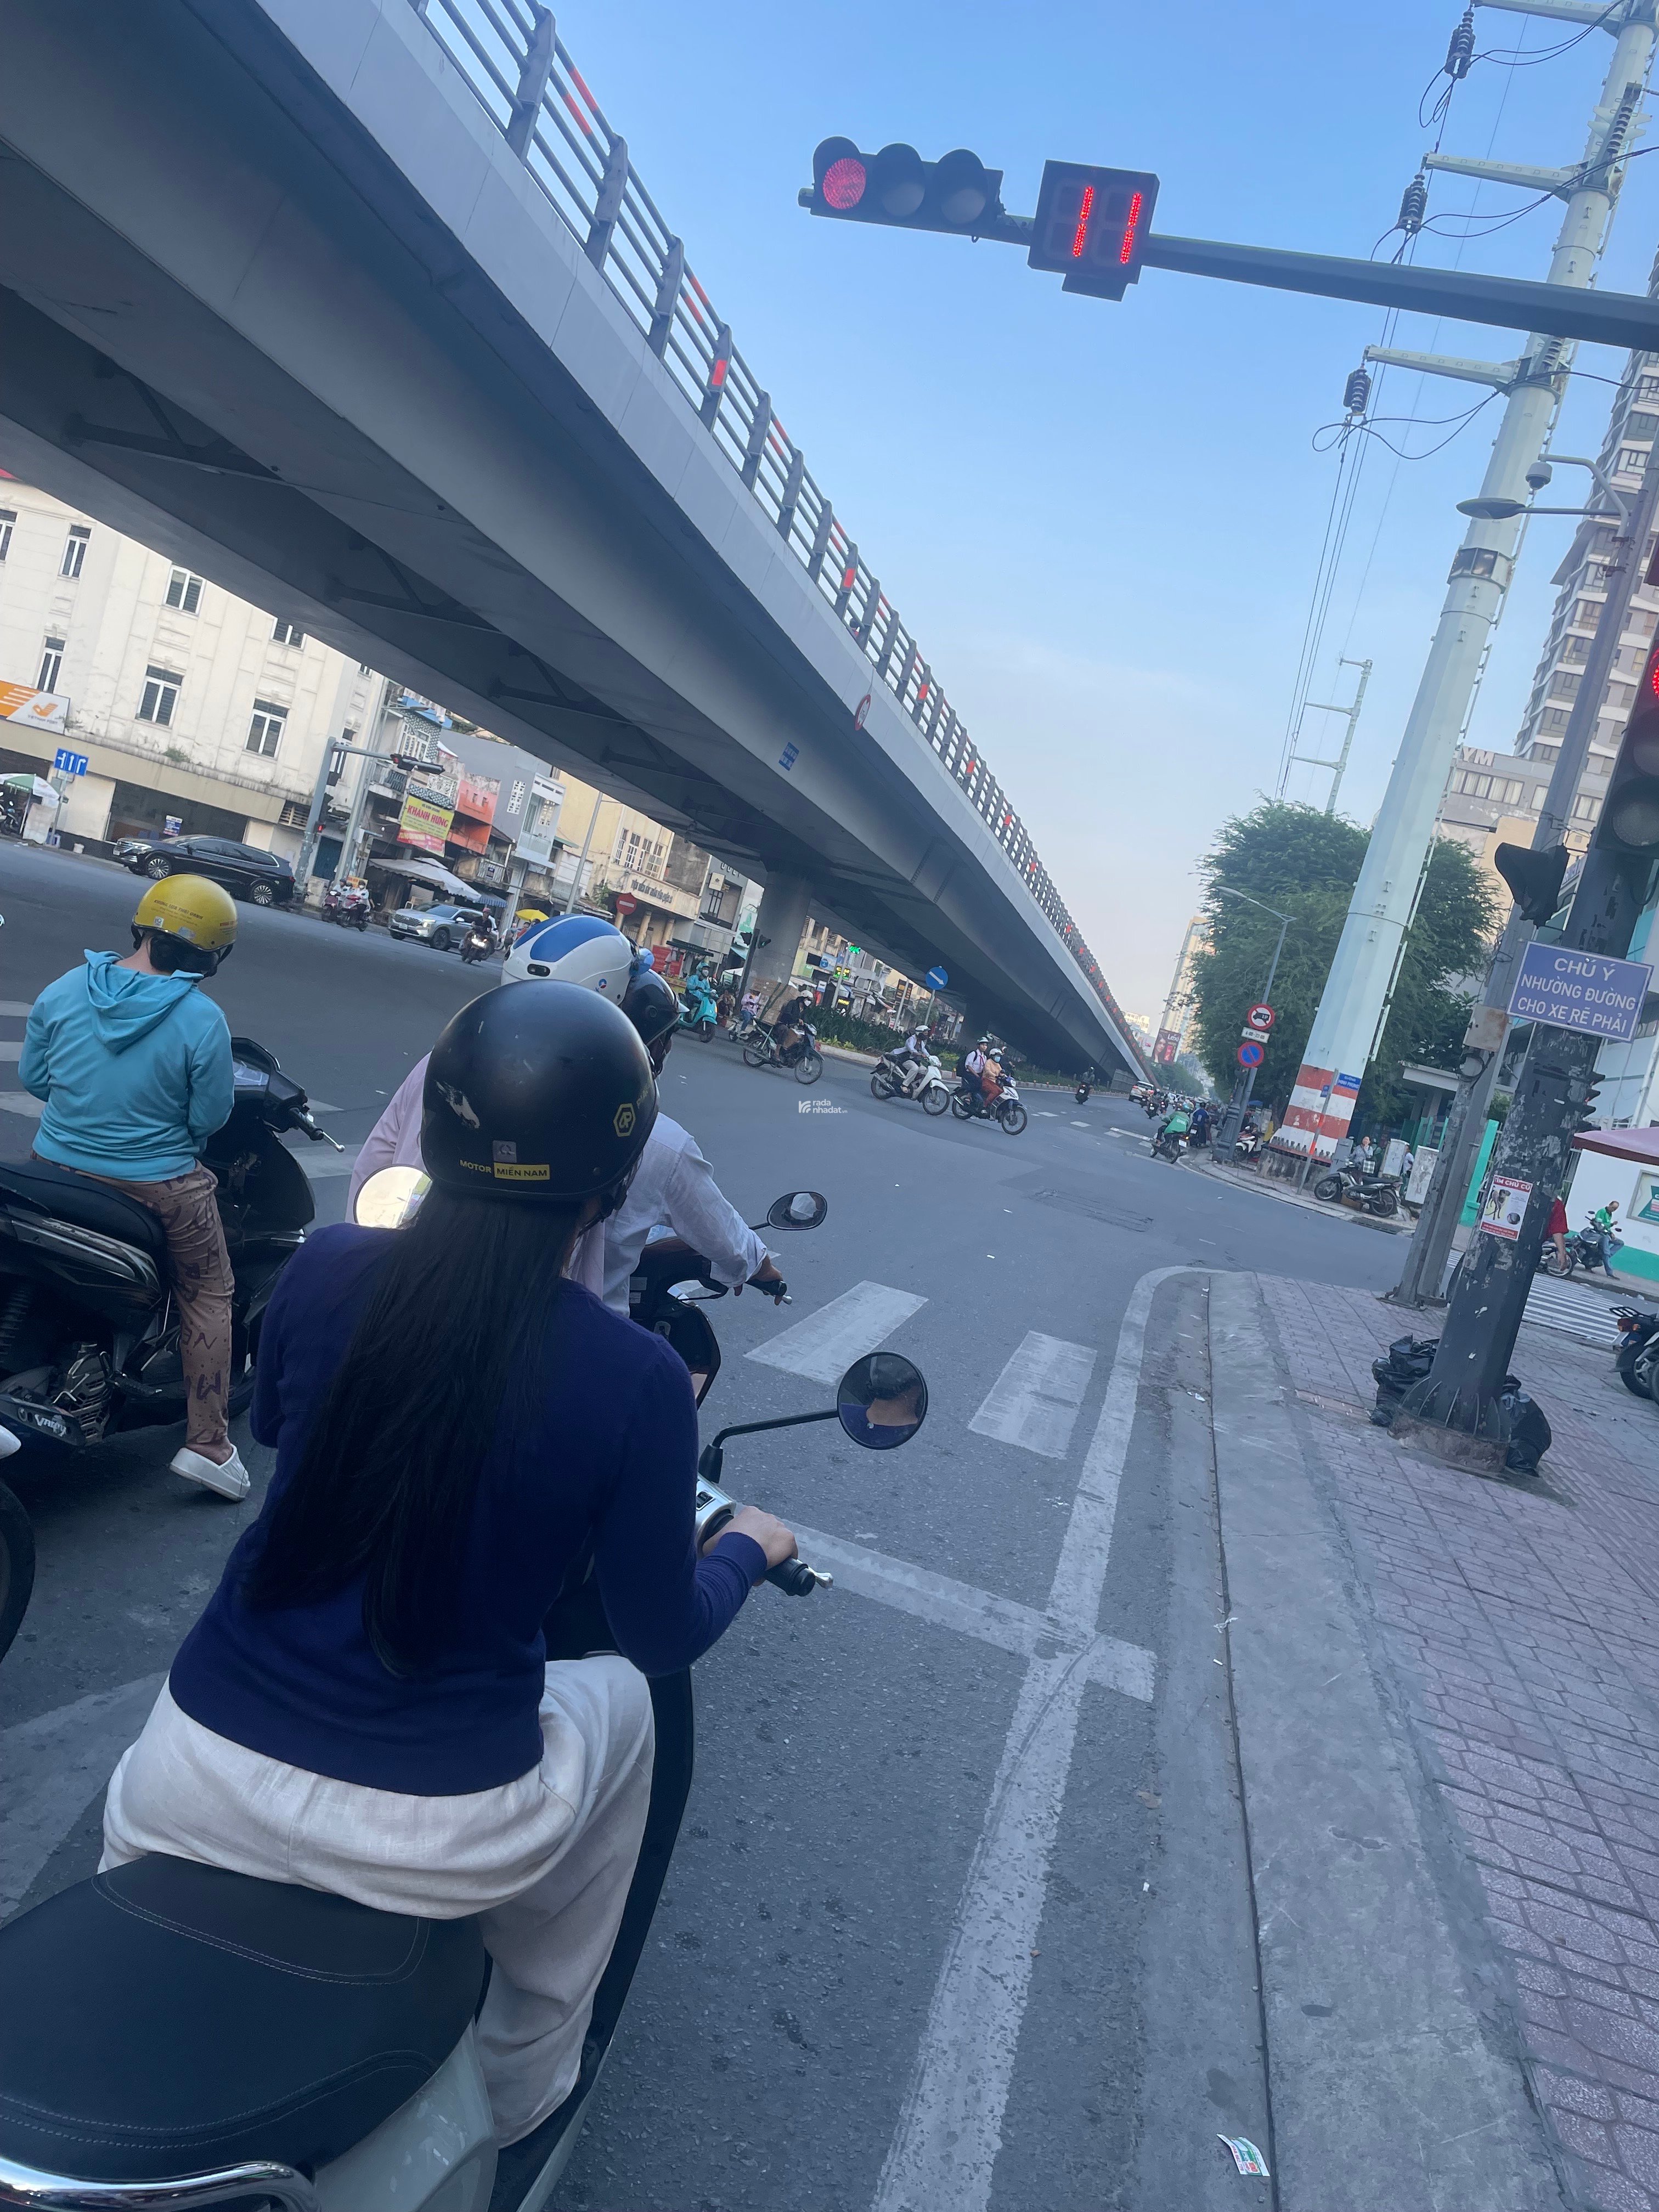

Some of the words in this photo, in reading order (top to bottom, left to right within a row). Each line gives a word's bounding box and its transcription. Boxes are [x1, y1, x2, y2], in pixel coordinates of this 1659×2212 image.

[1071, 185, 1142, 265] 11
[1463, 746, 1495, 766] YM
[1554, 958, 1597, 978] CHÚ
[1602, 963, 1616, 981] Ý
[1521, 974, 1582, 998] NHƯỜNG
[1584, 987, 1637, 1011] ĐƯỜNG
[1517, 997, 1546, 1014] CHO
[1548, 1003, 1568, 1020] XE
[1570, 1007, 1591, 1025] RẼ
[1591, 1013, 1627, 1032] PHẢI
[460, 1159, 492, 1173] MOTOR
